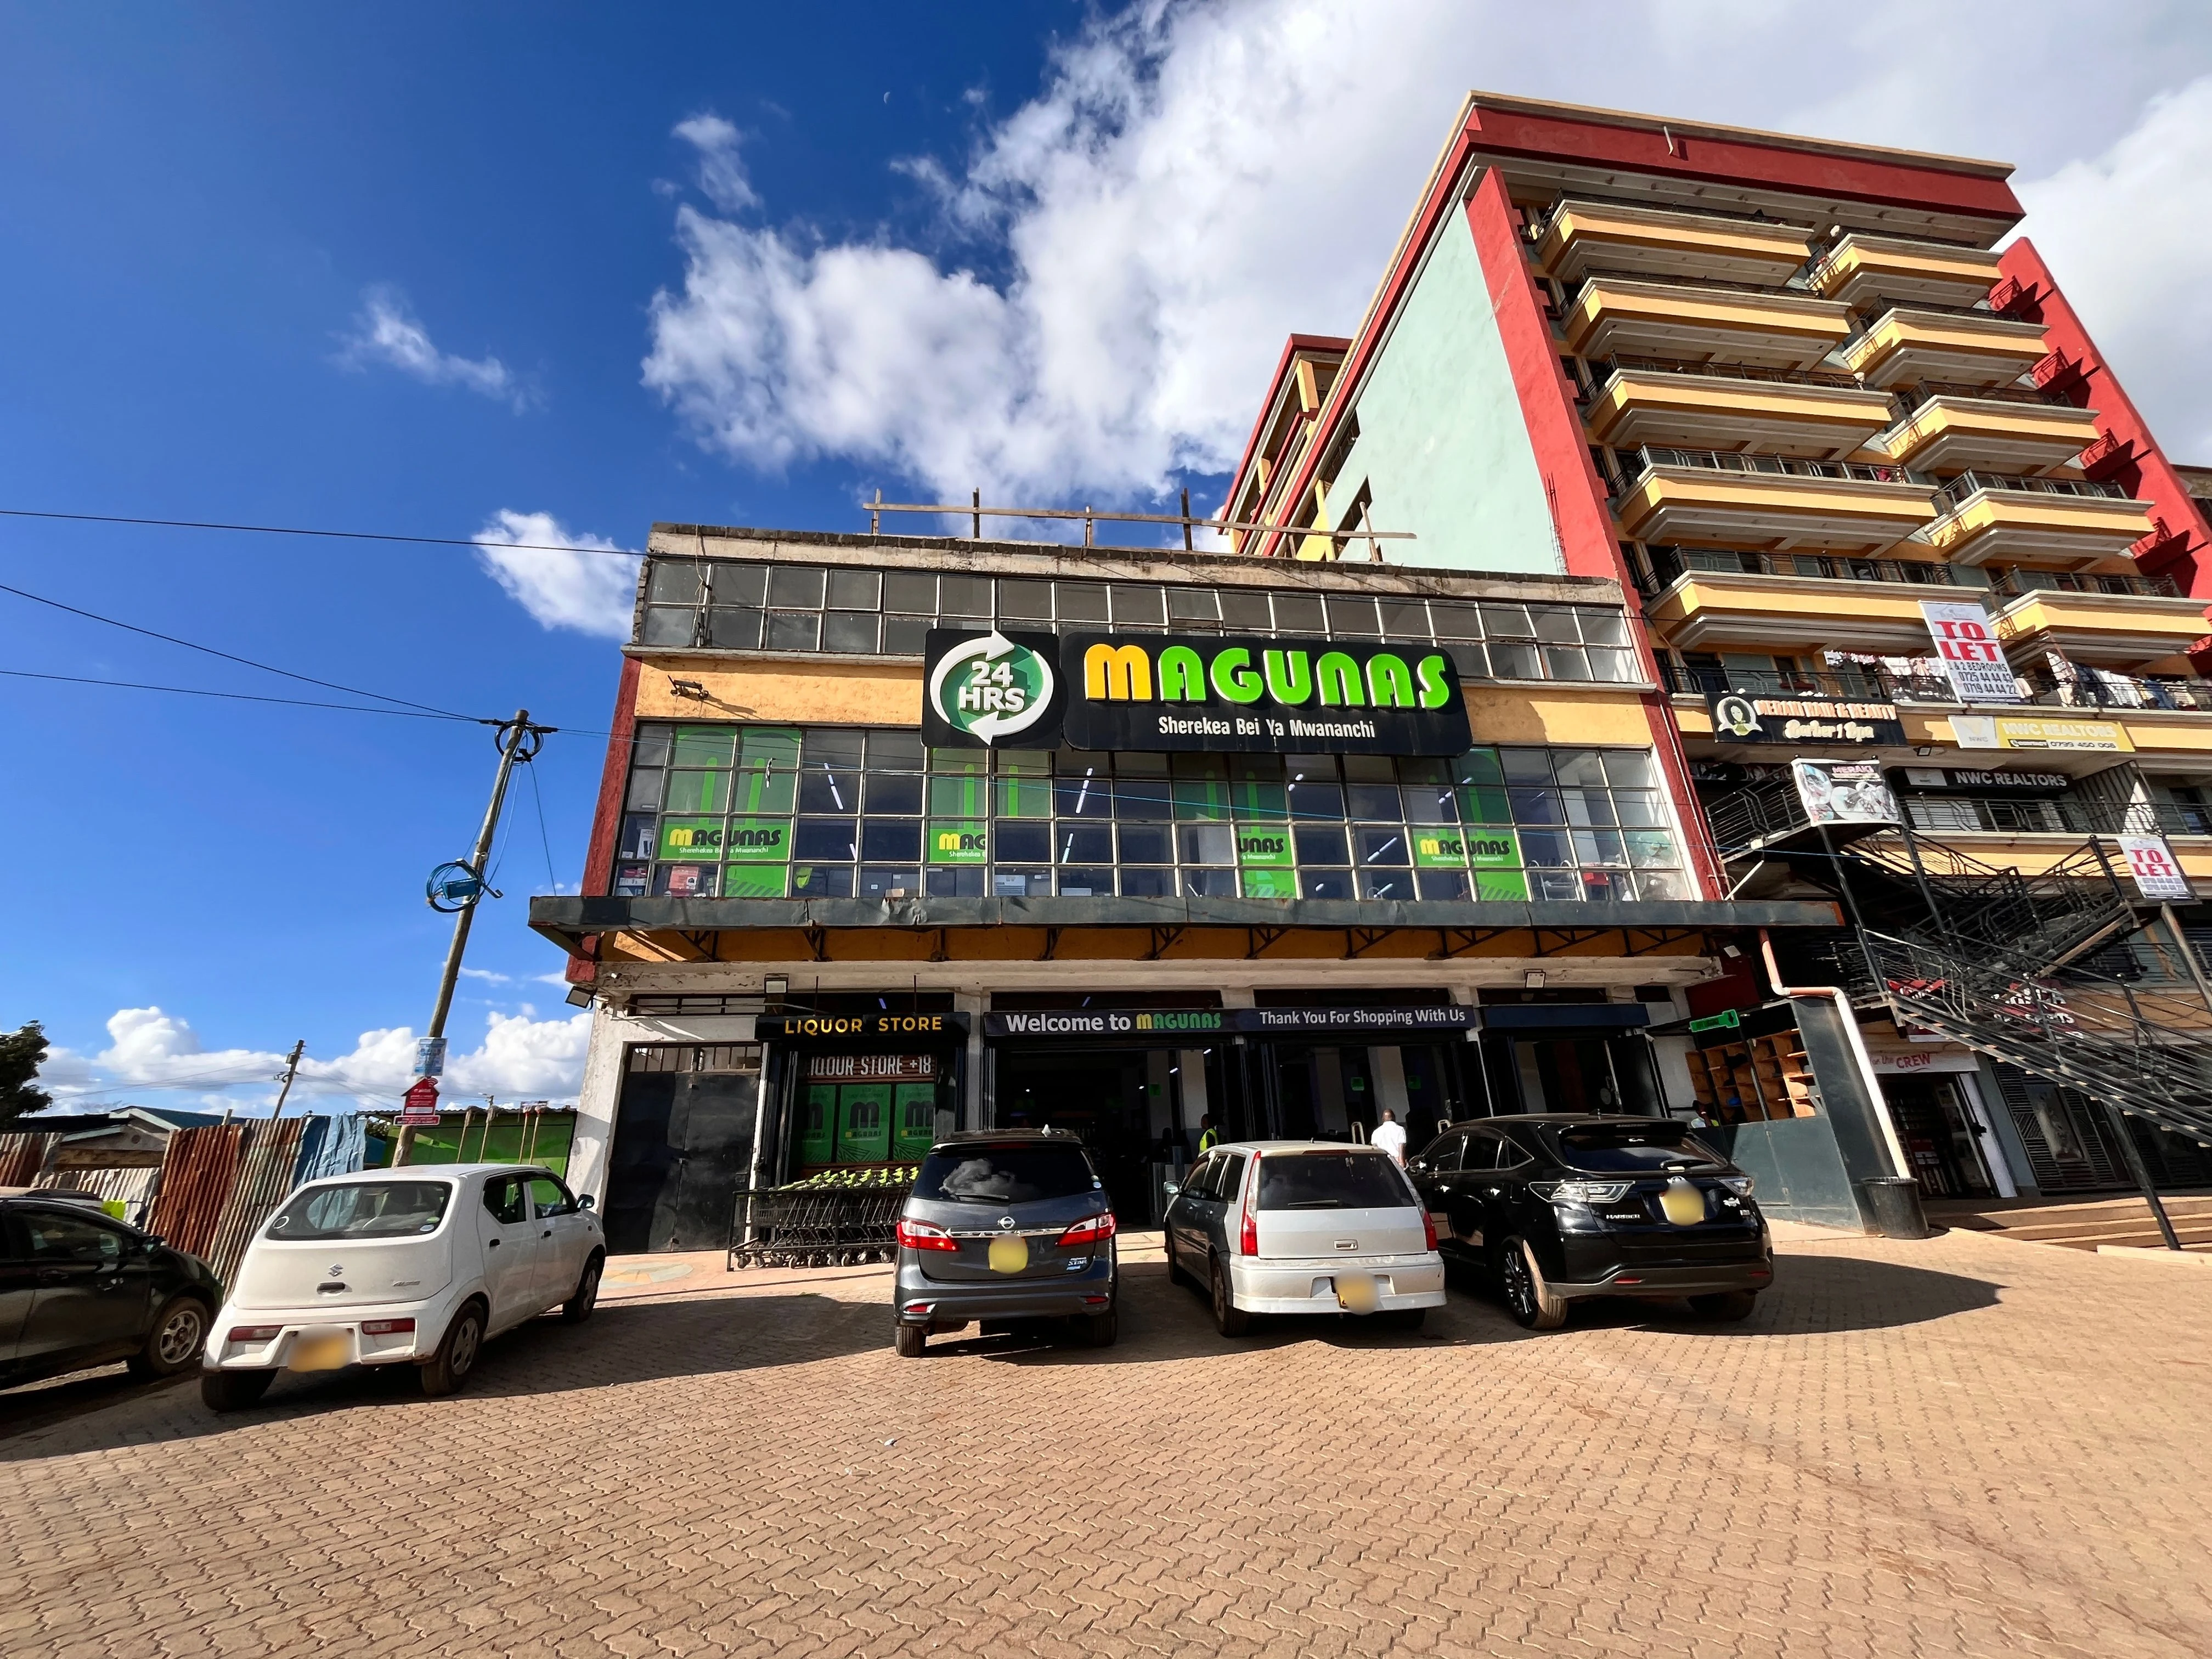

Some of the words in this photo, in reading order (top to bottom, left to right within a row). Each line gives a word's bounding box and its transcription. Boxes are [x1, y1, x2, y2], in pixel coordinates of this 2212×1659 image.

[1934, 621, 1986, 640] TO
[1939, 641, 1997, 661] LET
[971, 661, 1013, 687] 24
[1962, 662, 1967, 670] 2
[1967, 662, 2008, 672] BEDROOMS
[1084, 644, 1449, 708] MAGUNAS
[1959, 672, 1979, 681] 0725
[1980, 672, 1991, 681] 44
[1992, 673, 2002, 682] 44
[1963, 682, 1984, 693] 0719
[1984, 684, 1995, 693] 44
[1996, 684, 2006, 694] 44
[2006, 685, 2017, 694] 22
[959, 686, 1025, 712] HRS
[1159, 716, 1229, 735] Sherekea
[1237, 718, 1260, 736] Bei
[1266, 718, 1284, 737] Ya
[1290, 719, 1375, 738] Mwananchi
[2002, 723, 2041, 735] NWC
[2040, 724, 2117, 737] REALTORS
[1955, 771, 1993, 785] NWC
[1994, 773, 2067, 786] REALTORS
[669, 828, 782, 846] MAGUNAS
[1237, 837, 1284, 853] UNAS
[1420, 839, 1510, 855] MAGUNAS
[2129, 849, 2164, 863] TO
[2132, 864, 2174, 876] LET
[1006, 1013, 1104, 1032] Welcome
[1109, 1014, 1131, 1030] to
[1136, 1013, 1221, 1029] MAGUNAS
[1259, 1011, 1300, 1024] Thank
[1302, 1011, 1326, 1024] You
[1330, 1011, 1350, 1023] For
[1353, 1010, 1413, 1025] Shopping
[1414, 1009, 1446, 1022] With
[1449, 1009, 1465, 1022] Us
[785, 1019, 862, 1036] LIQUOR
[878, 1016, 943, 1032] STORE
[808, 1056, 854, 1076] IQOUR
[860, 1055, 903, 1075] STORE
[910, 1054, 932, 1074] +18
[1896, 1053, 1931, 1069] CREW
